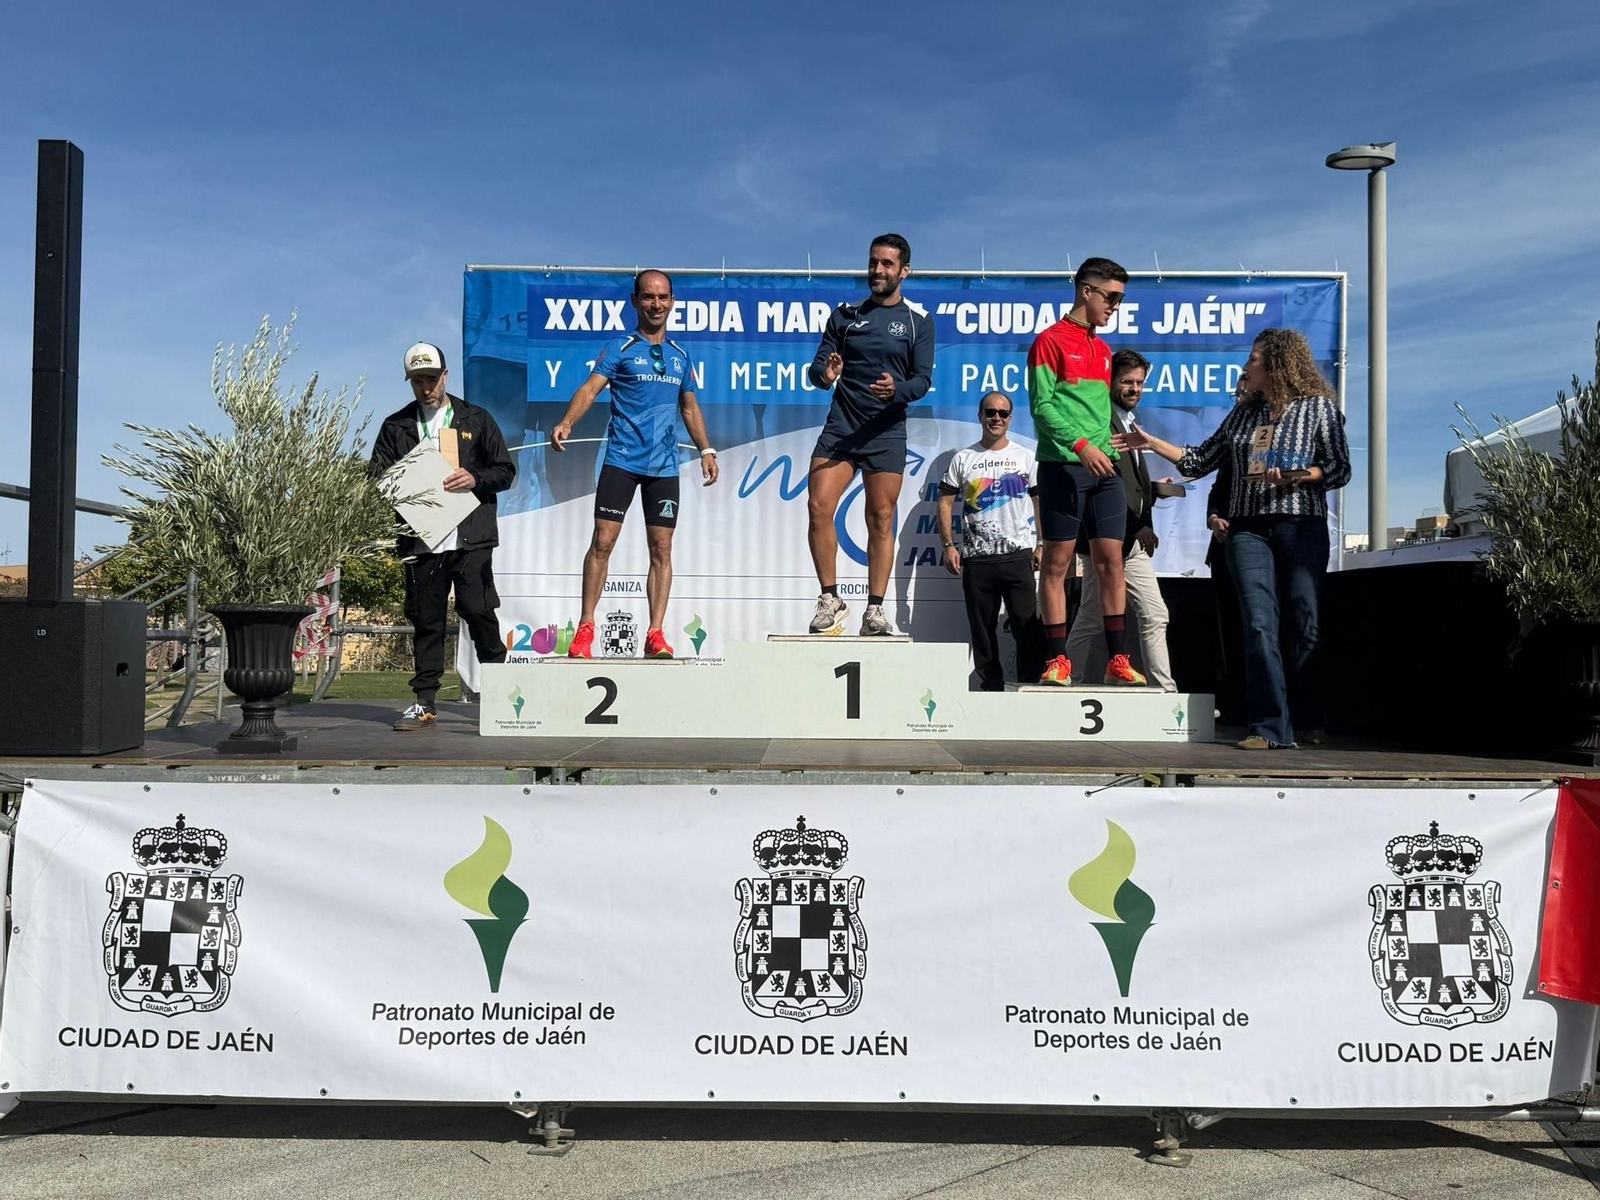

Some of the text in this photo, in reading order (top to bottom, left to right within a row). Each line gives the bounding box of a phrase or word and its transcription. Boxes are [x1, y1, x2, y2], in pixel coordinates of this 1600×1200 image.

[544, 298, 626, 331] XXIX
[666, 300, 744, 332] EDIA
[544, 360, 562, 388] Y
[1142, 363, 1243, 393] ZANED
[1260, 429, 1268, 440] 2
[972, 458, 1017, 471] calderón
[603, 581, 642, 592] GANIZA
[506, 655, 529, 664] Jaén
[834, 662, 861, 720] 1
[584, 676, 618, 725] 2
[1079, 699, 1105, 735] 3
[228, 880, 236, 909] CASTILLA
[849, 882, 857, 910] CASTILLA
[1486, 887, 1494, 915] CASTILLA
[227, 913, 234, 922] DE
[851, 915, 858, 925] DE
[1490, 920, 1499, 930] DE
[226, 962, 232, 972] DE
[856, 966, 862, 976] DE
[111, 979, 116, 987] DE
[1503, 972, 1510, 982] DE
[744, 985, 750, 994] DE
[1383, 992, 1390, 1002] DE
[145, 1003, 173, 1012] GUARDA
[372, 1003, 615, 1025] Patronato Municipal de
[779, 1008, 807, 1017] GUARDA
[1005, 1006, 1249, 1030] Patronato Municipal de
[1424, 1016, 1454, 1025] GUARDA
[58, 1026, 274, 1053] CIUDAD DE JAÉN
[399, 1026, 586, 1050] Deportes de Jaén
[694, 1030, 908, 1056] CIUDAD DE JAÉN
[1034, 1030, 1222, 1053] Deportes de Jaén
[1337, 1036, 1553, 1063] CIUDAD DE JAÉN
